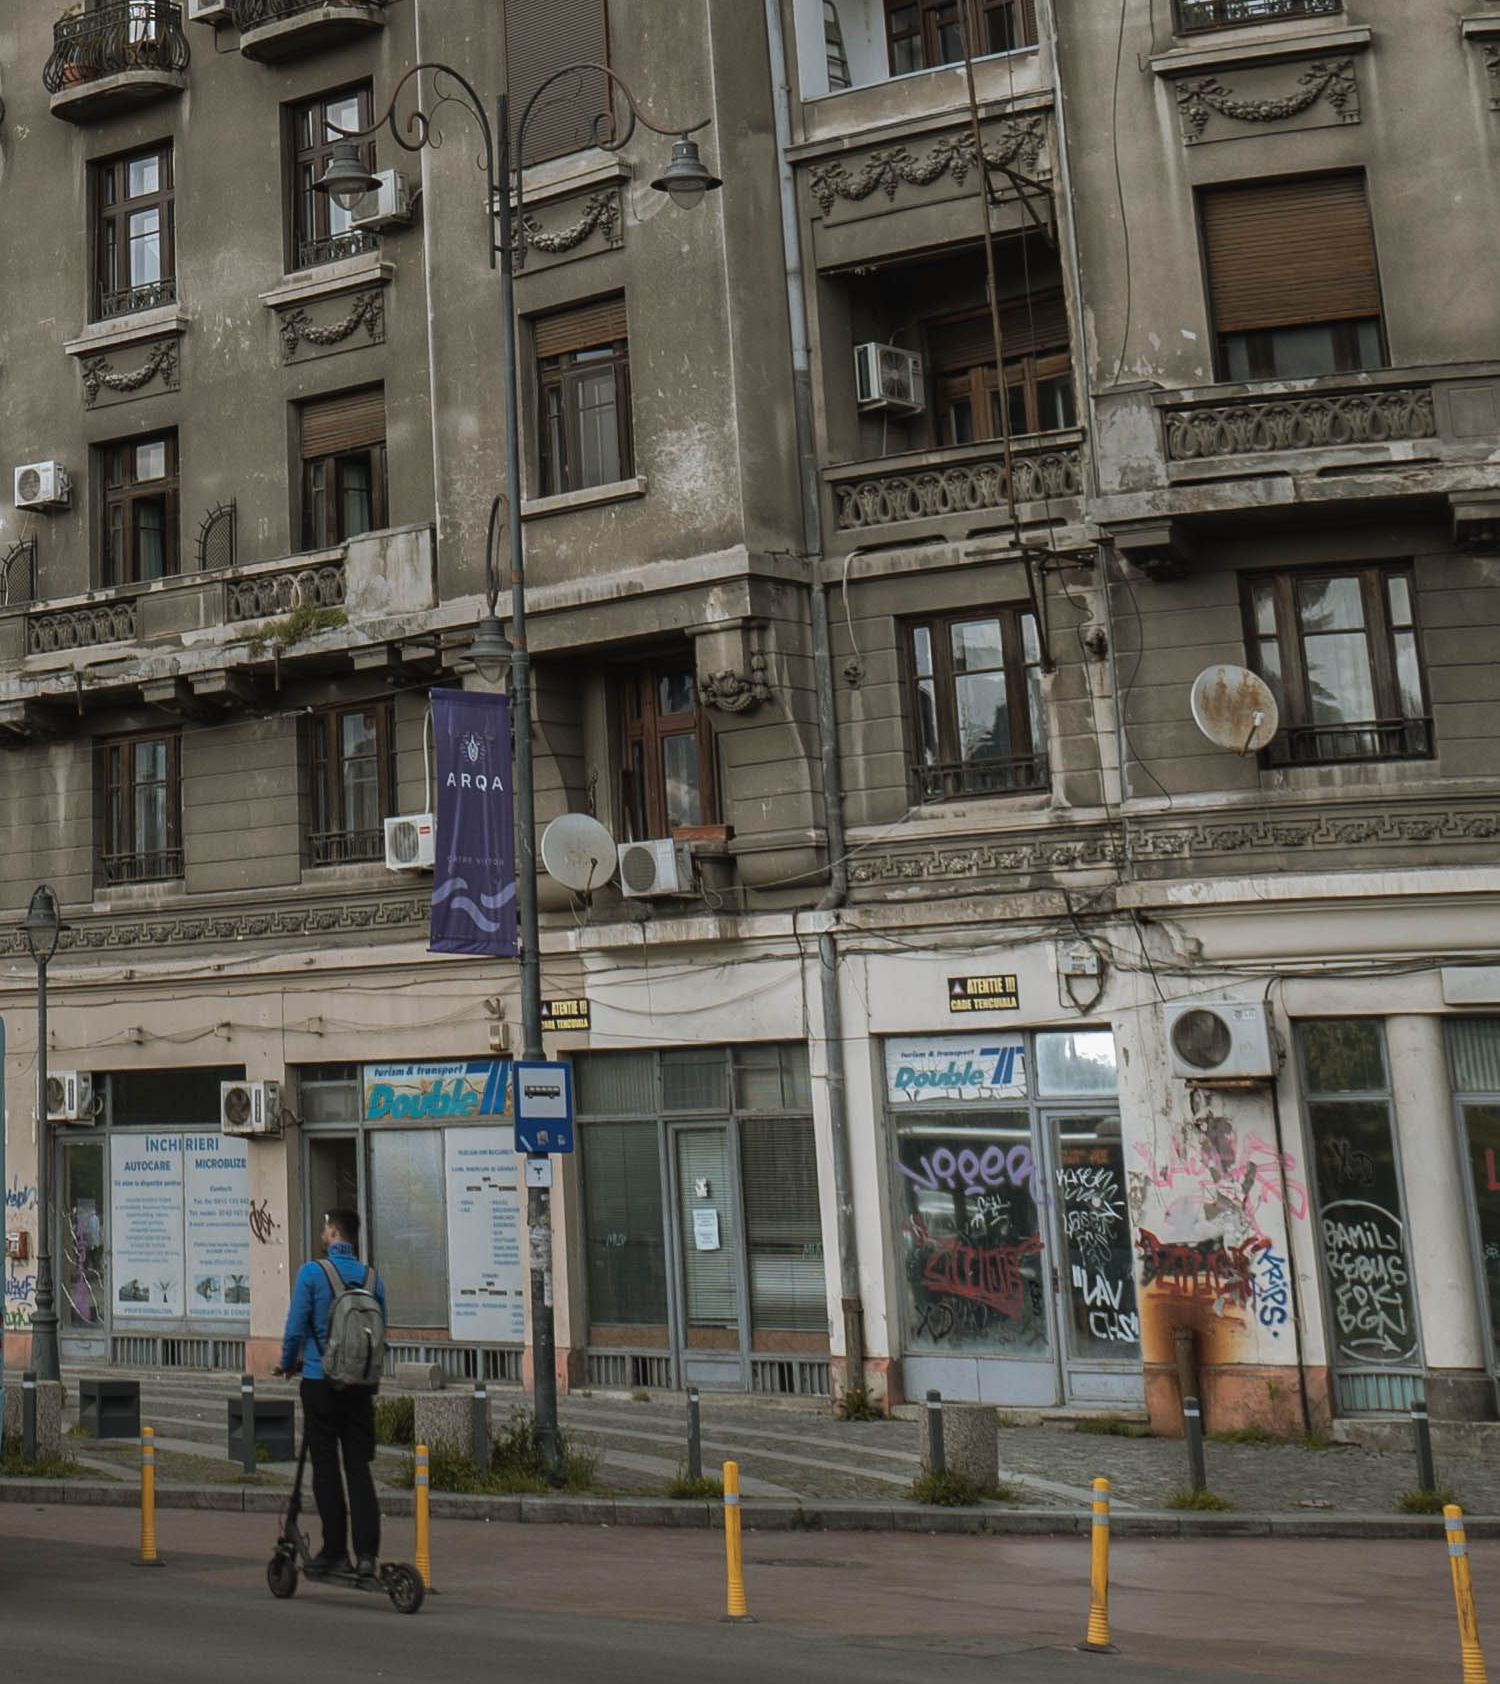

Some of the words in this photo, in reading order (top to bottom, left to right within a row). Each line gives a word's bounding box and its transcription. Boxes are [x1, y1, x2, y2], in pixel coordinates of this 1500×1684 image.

[447, 772, 504, 792] ARQA
[374, 1066, 404, 1077] turism
[406, 1066, 413, 1076] &
[416, 1064, 464, 1077] transport
[895, 1061, 984, 1088] Double
[366, 1078, 480, 1120] Double
[124, 1160, 171, 1172] AUTOCARE
[195, 1158, 247, 1171] MICROBUZE
